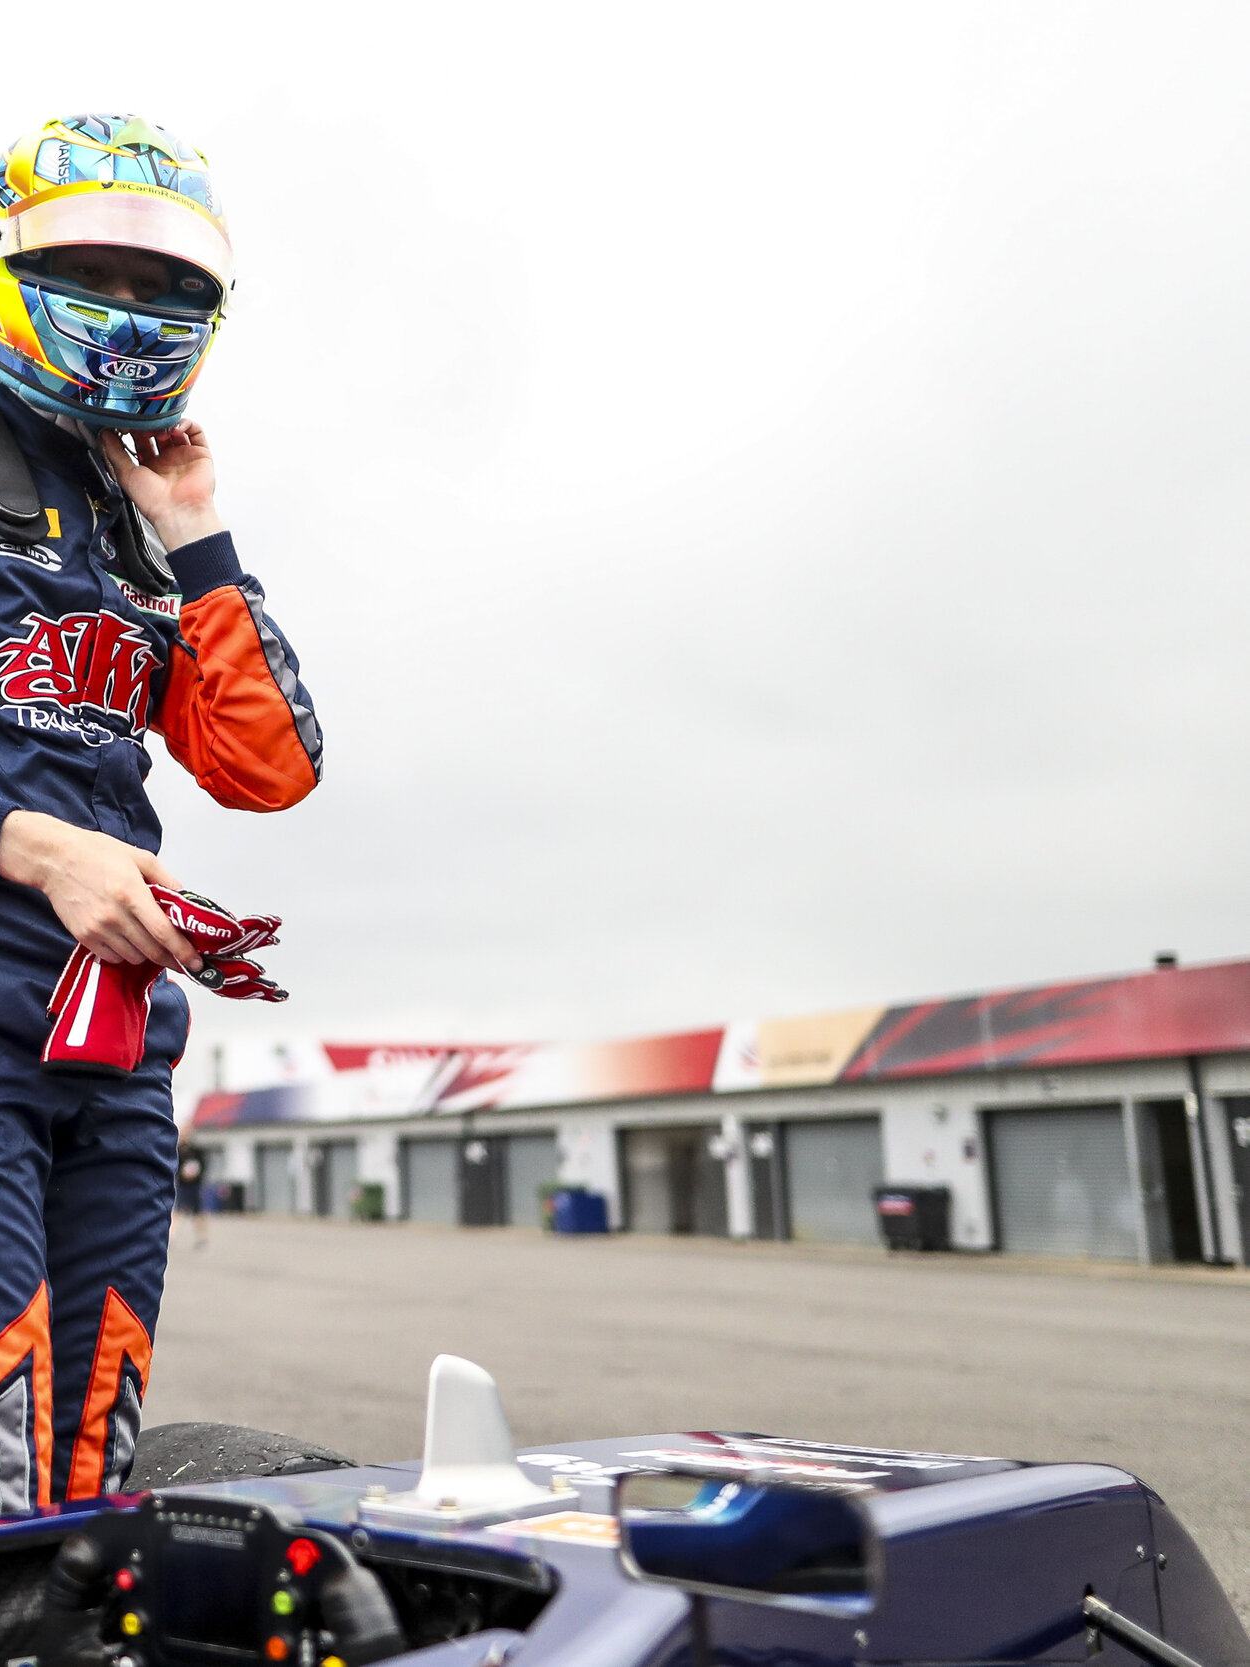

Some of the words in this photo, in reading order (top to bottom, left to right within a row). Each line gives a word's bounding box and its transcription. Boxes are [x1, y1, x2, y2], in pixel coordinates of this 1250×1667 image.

[117, 182, 196, 210] @CarlinRacing
[112, 361, 145, 378] VGL
[120, 582, 177, 616] Castrol
[185, 914, 232, 939] freem
